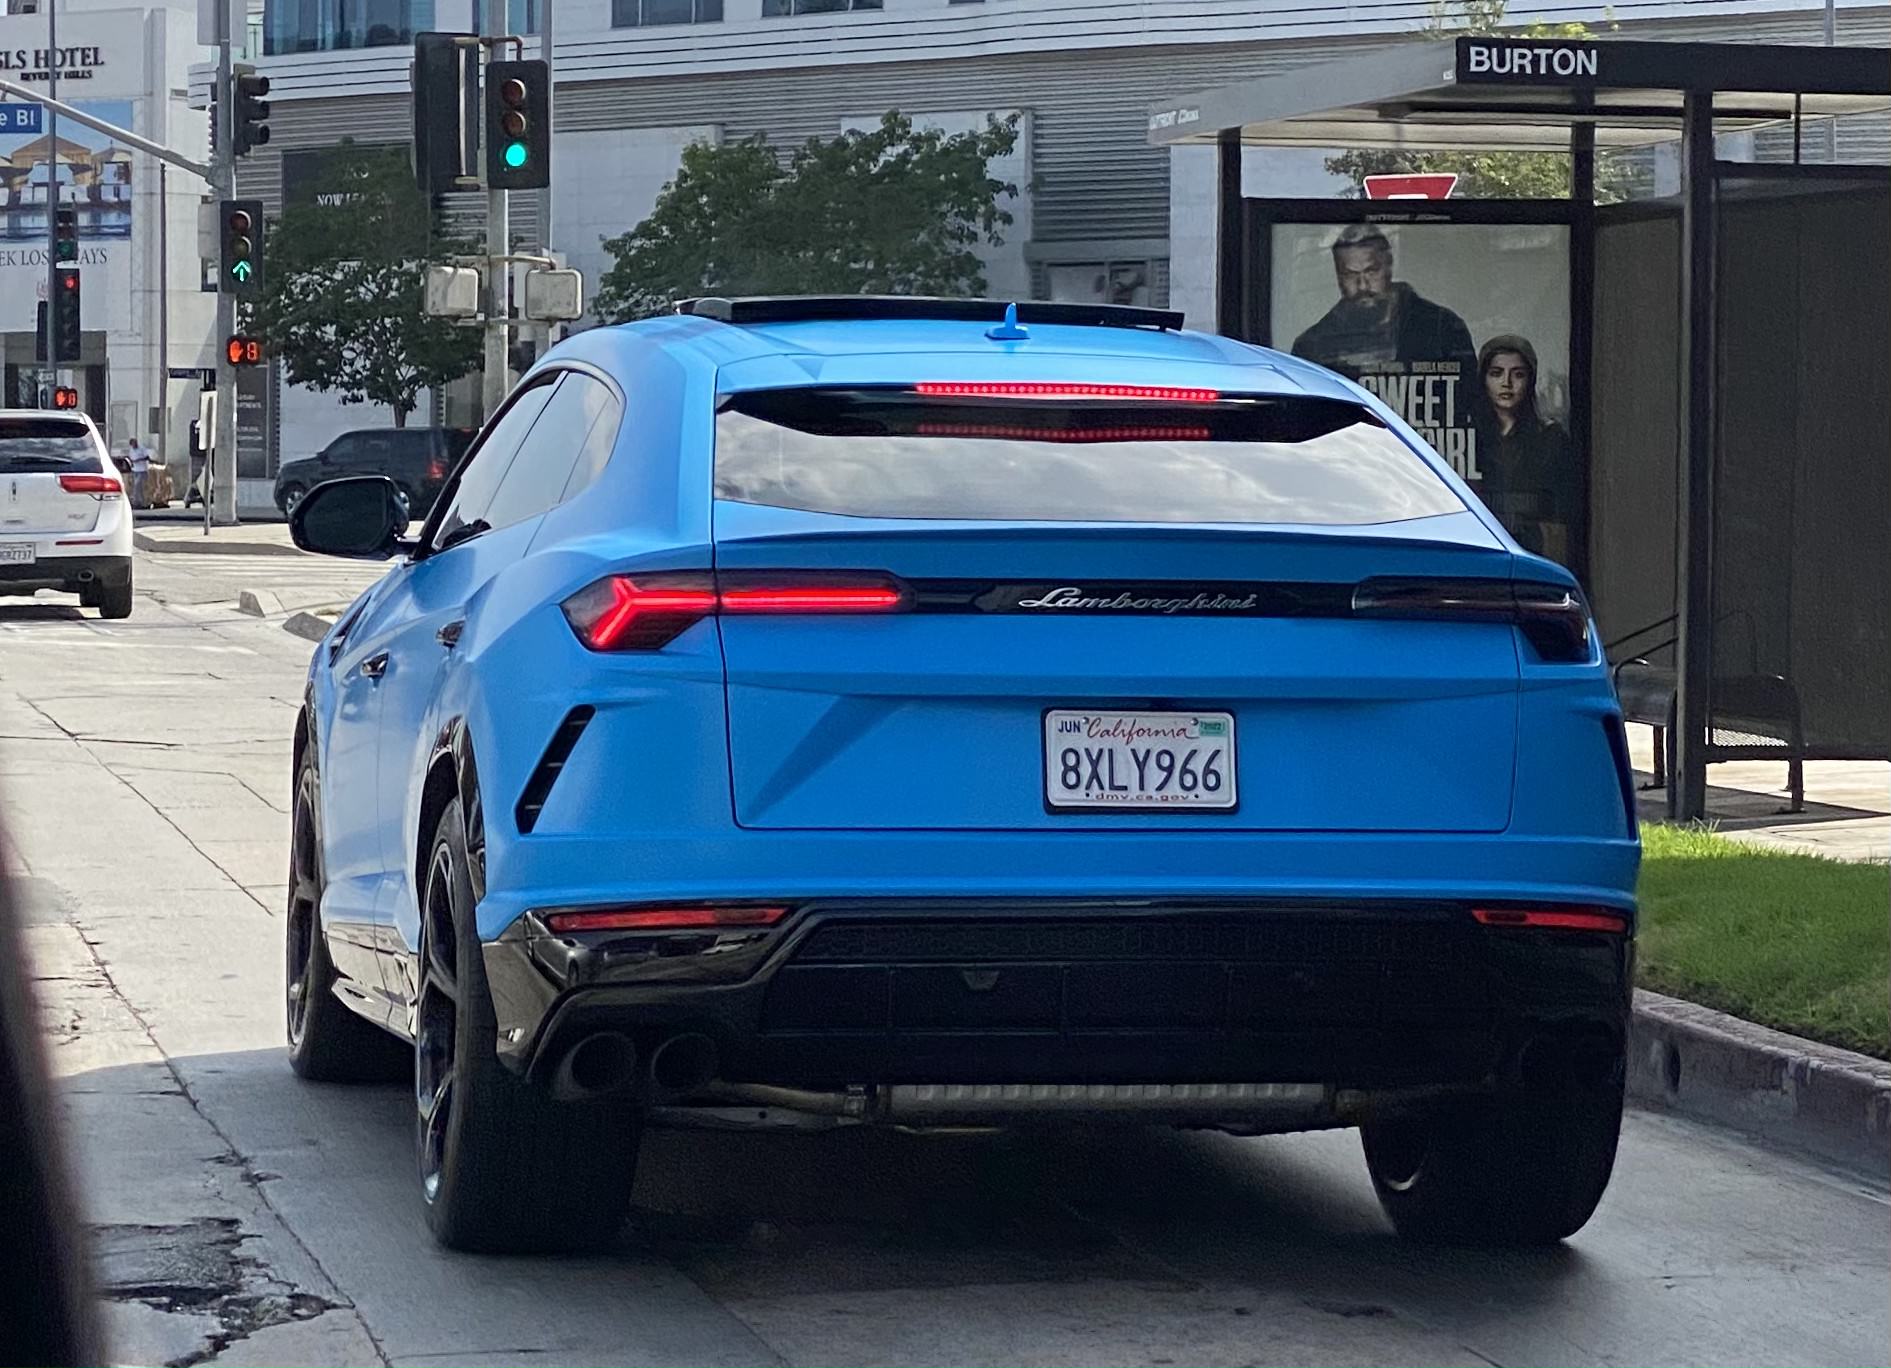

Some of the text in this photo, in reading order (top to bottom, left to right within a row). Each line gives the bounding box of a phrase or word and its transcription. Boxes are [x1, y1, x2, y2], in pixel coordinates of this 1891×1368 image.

[34, 46, 105, 69] HOTEL
[1469, 46, 1597, 76] BURTON
[1018, 586, 1257, 614] Lamborghini
[1058, 720, 1081, 733] JUN
[1086, 717, 1200, 746] California
[1060, 748, 1222, 792] 8XLY966
[1095, 792, 1189, 801] dmv.ca.gov
